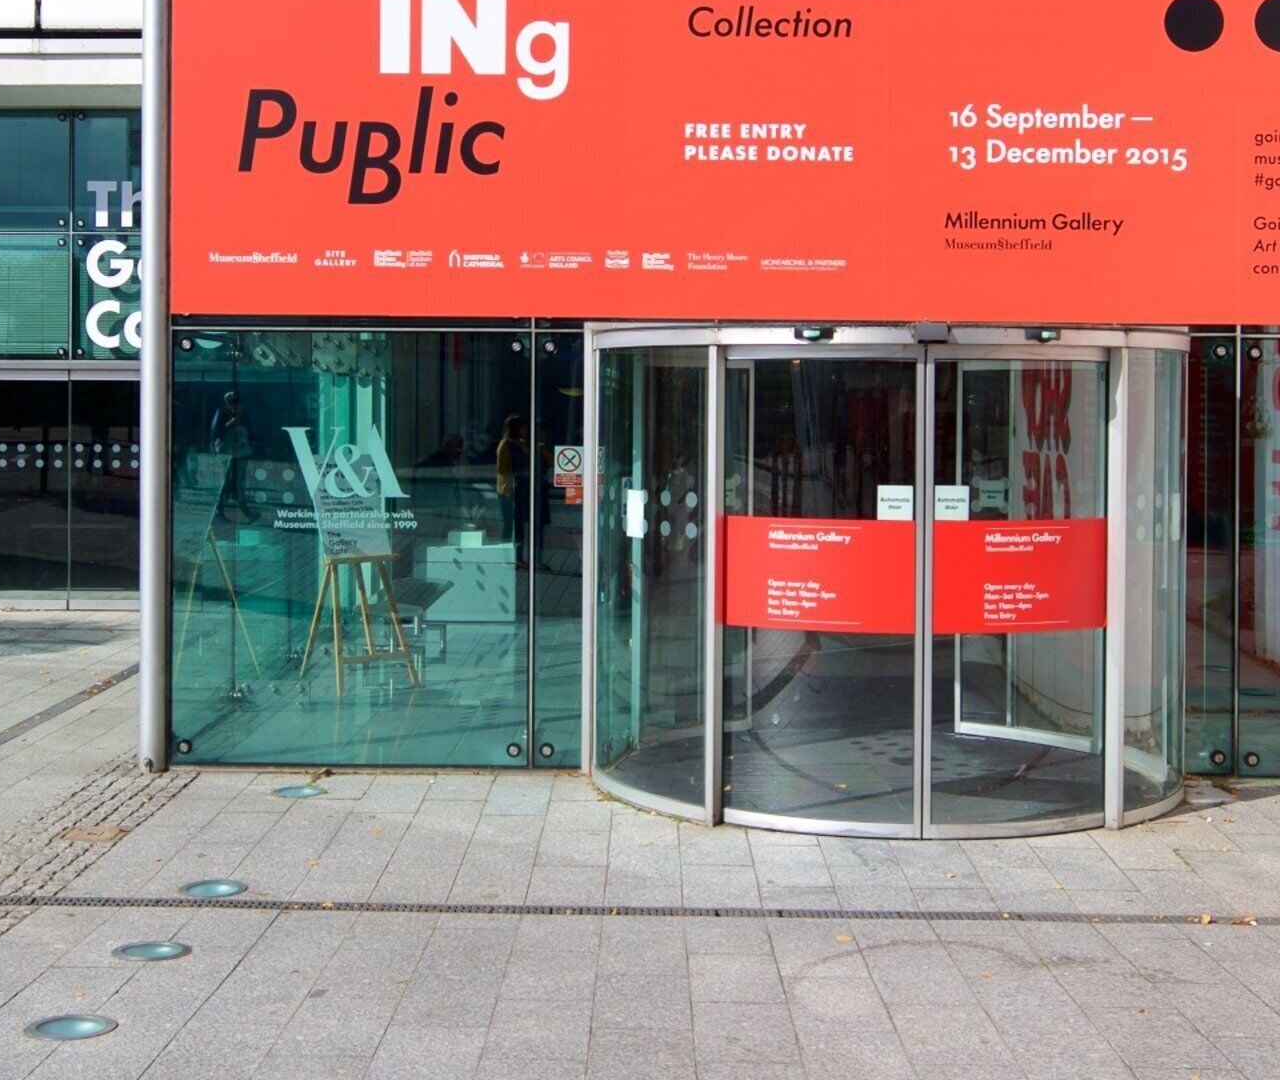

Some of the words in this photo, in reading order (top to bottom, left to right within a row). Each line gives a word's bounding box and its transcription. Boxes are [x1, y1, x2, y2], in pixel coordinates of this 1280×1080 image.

[688, 5, 852, 37] Collection
[949, 104, 978, 128] 16
[986, 104, 1125, 134] September
[684, 123, 731, 138] FREE
[740, 123, 807, 139] ENTRY
[684, 145, 758, 161] PLEASE
[767, 146, 854, 161] DONATE
[949, 146, 976, 170] 13
[986, 138, 1118, 164] December
[1125, 148, 1188, 171] 2015
[944, 211, 1046, 230] Millennium
[1052, 212, 1123, 236] Gallery
[1253, 239, 1277, 253] Art
[314, 259, 357, 267] GALLERY
[281, 424, 411, 499] V&A
[277, 509, 317, 520] Working
[322, 510, 330, 519] in
[333, 510, 389, 521] partnership
[392, 510, 414, 519] with
[274, 520, 318, 529] Museums
[322, 520, 365, 529] Sheffield
[367, 521, 391, 529] since
[393, 521, 417, 529] 1999
[768, 530, 815, 541] Millennium
[816, 532, 851, 544] Gallery
[985, 533, 1031, 543] Millennium
[1032, 532, 1062, 544] Gallery
[768, 579, 786, 588] Open
[787, 581, 805, 589] every
[807, 580, 820, 590] day
[984, 583, 1003, 591] Open
[1023, 582, 1035, 591] day
[782, 607, 799, 618] Entry
[999, 612, 1016, 620] Entry
